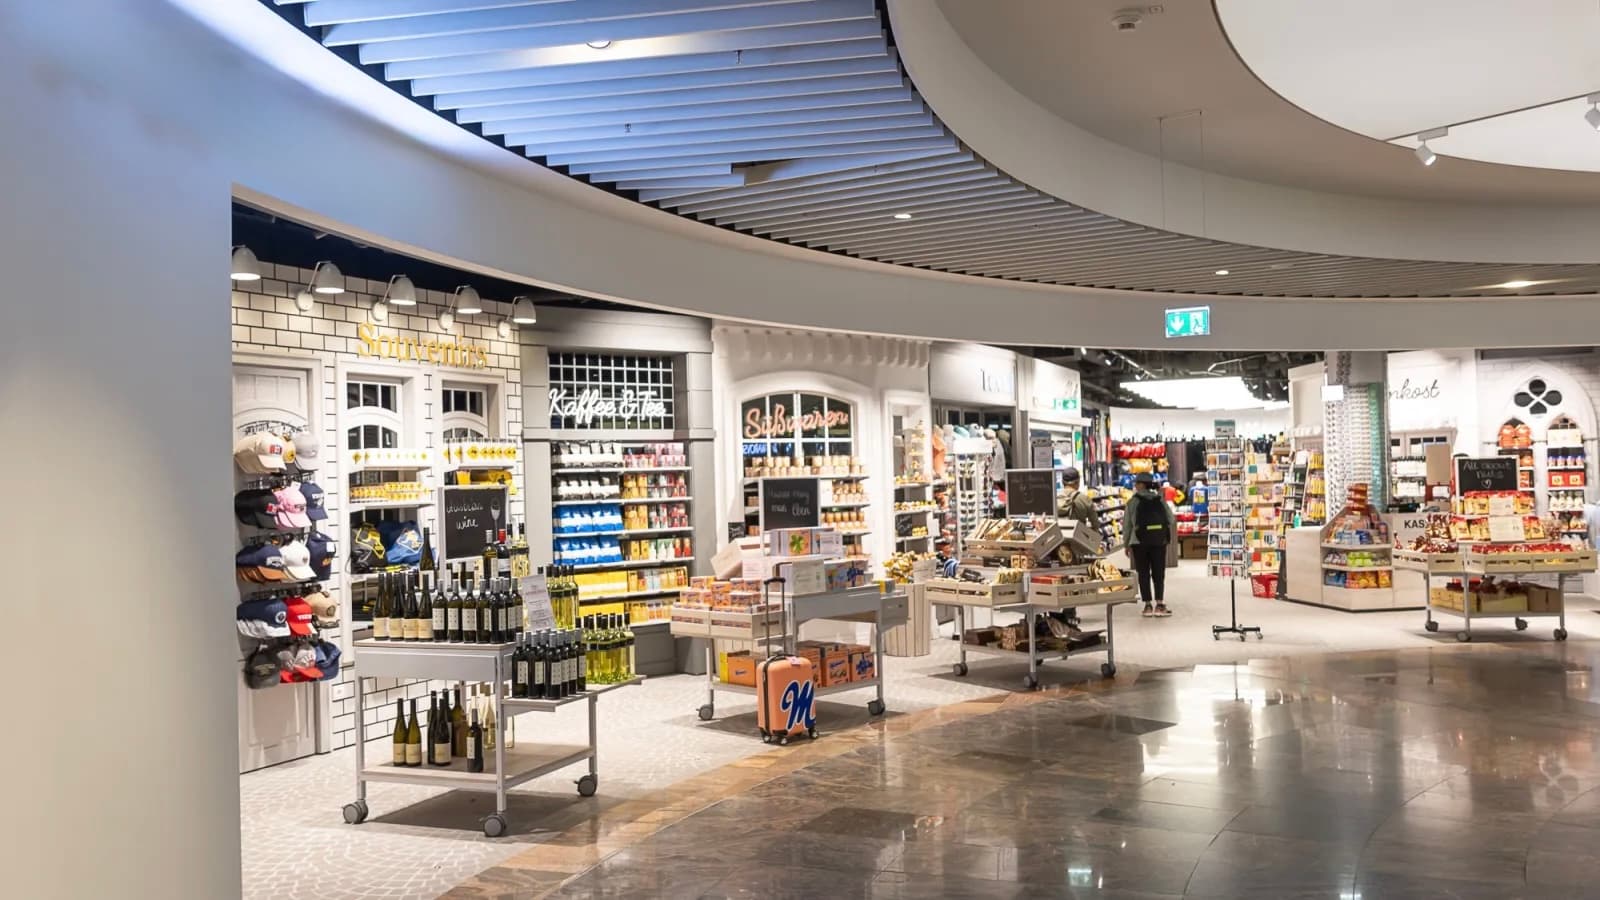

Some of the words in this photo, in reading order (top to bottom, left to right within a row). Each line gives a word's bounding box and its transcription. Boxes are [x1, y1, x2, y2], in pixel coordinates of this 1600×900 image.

[357, 321, 487, 369] Souvenirs
[548, 388, 617, 424] Kaffee
[620, 388, 637, 419] &
[637, 390, 667, 421] Tee
[745, 402, 849, 439] Süßwaren
[456, 516, 478, 530] wine
[780, 680, 817, 731] M
